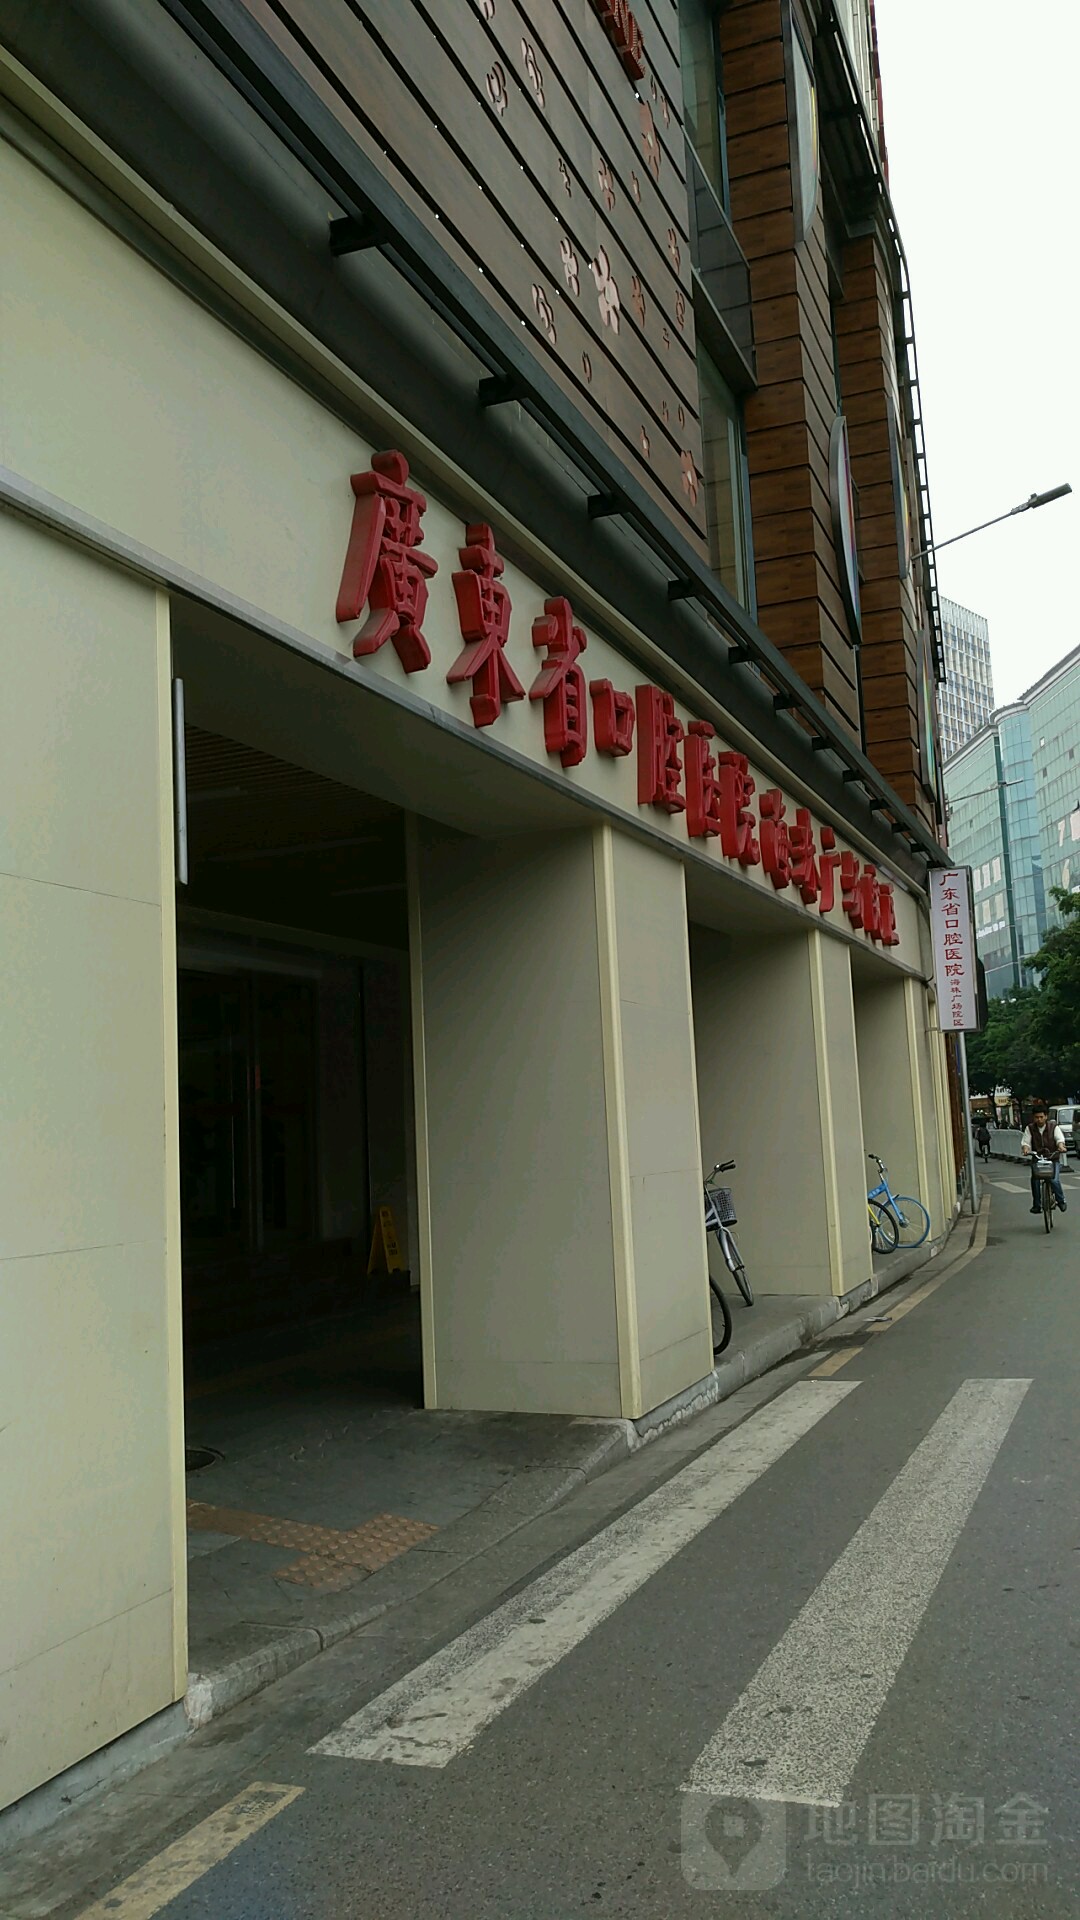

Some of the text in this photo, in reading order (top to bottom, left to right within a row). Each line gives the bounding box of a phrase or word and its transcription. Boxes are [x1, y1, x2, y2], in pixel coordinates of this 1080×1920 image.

[939, 872, 965, 977] 广东省口腔医院
[949, 978, 965, 1027] 海珠广场院区
